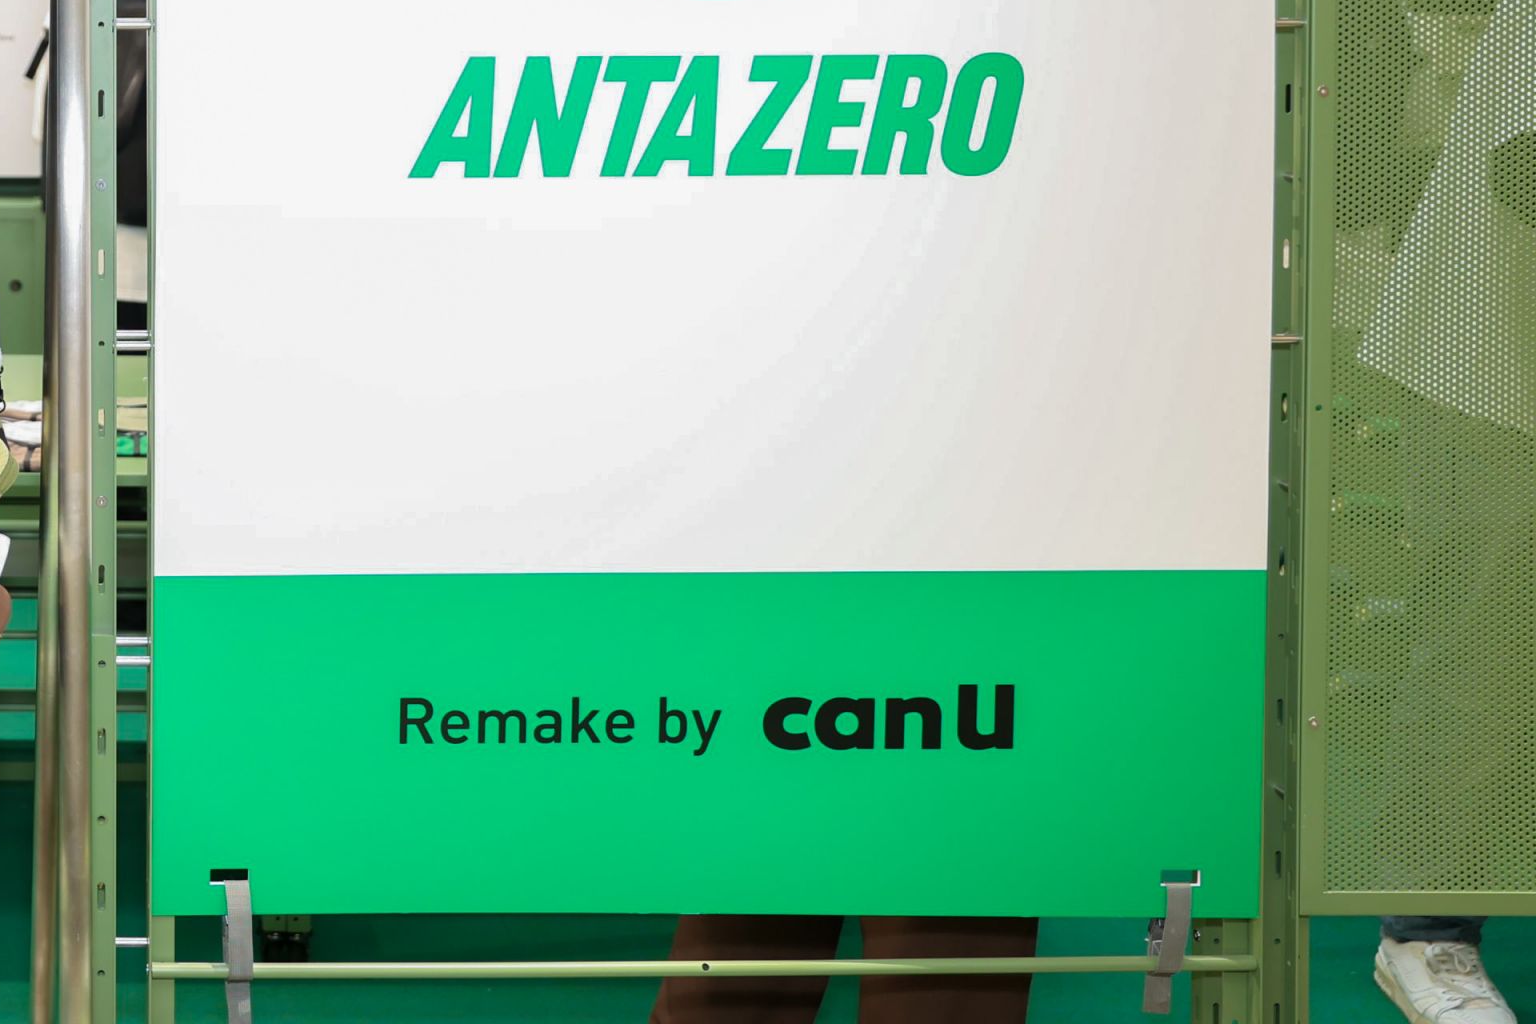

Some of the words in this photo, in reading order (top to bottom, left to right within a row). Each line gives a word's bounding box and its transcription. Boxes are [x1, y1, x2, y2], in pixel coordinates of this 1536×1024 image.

[408, 52, 1025, 178] ANTAZERO
[398, 697, 635, 745] Remake
[658, 697, 722, 756] by
